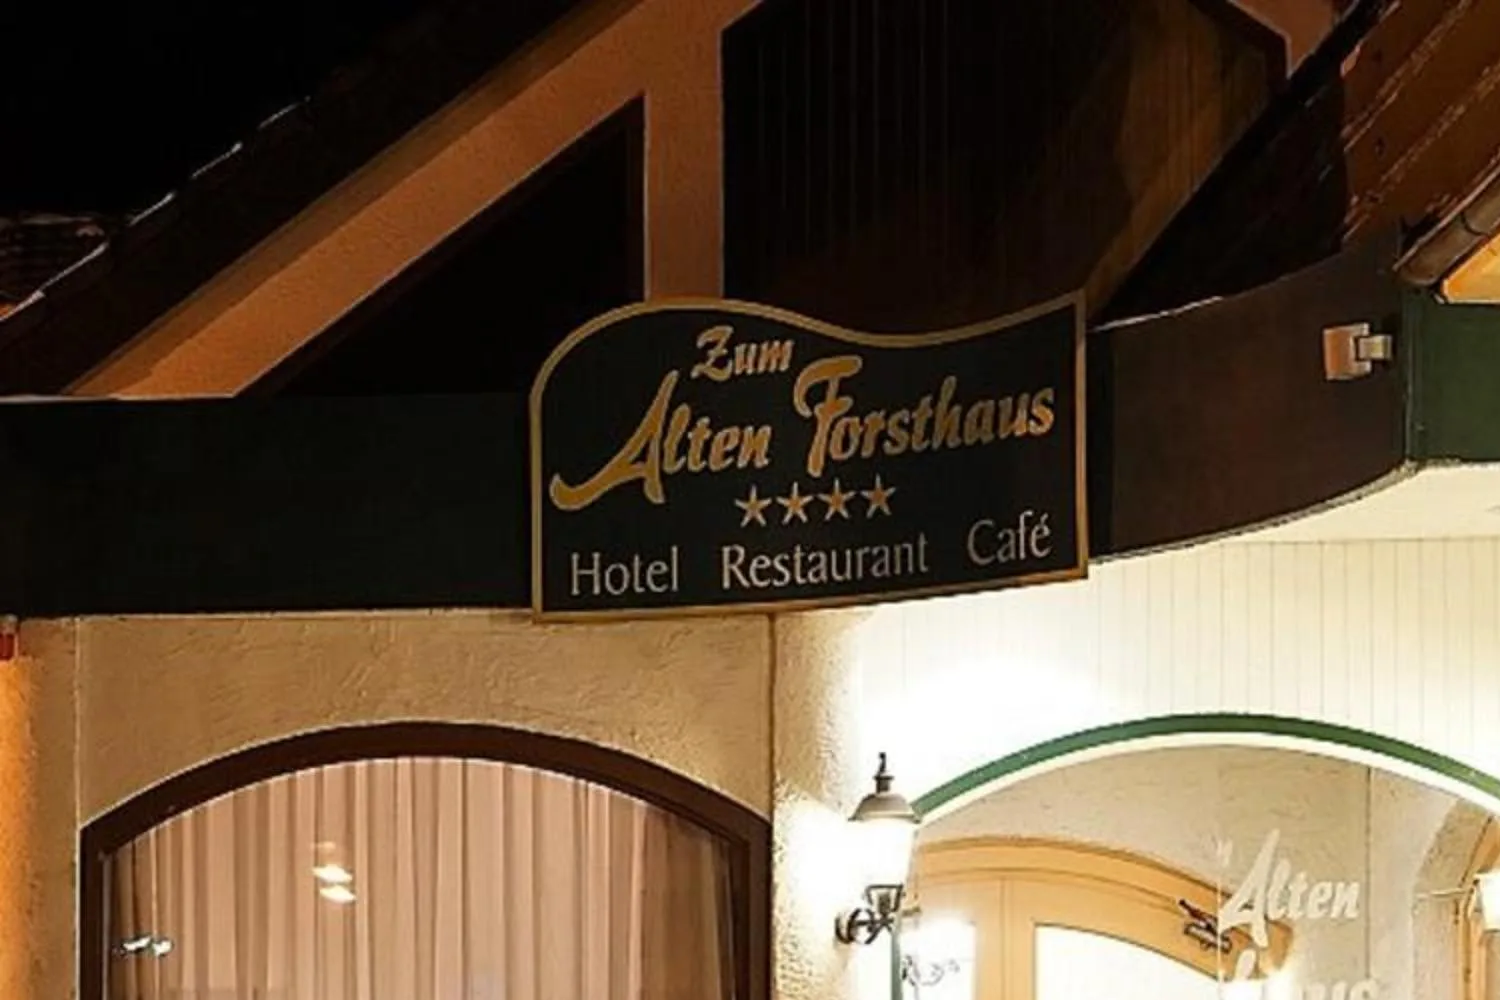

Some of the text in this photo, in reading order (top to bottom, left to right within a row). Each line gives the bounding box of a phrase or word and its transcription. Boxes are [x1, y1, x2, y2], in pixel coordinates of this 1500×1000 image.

[690, 324, 795, 381] Zum
[549, 354, 1055, 511] Alten Forsthaus
[570, 508, 1053, 596] Hotel Restaurant Café
[1218, 828, 1360, 947] Alten
